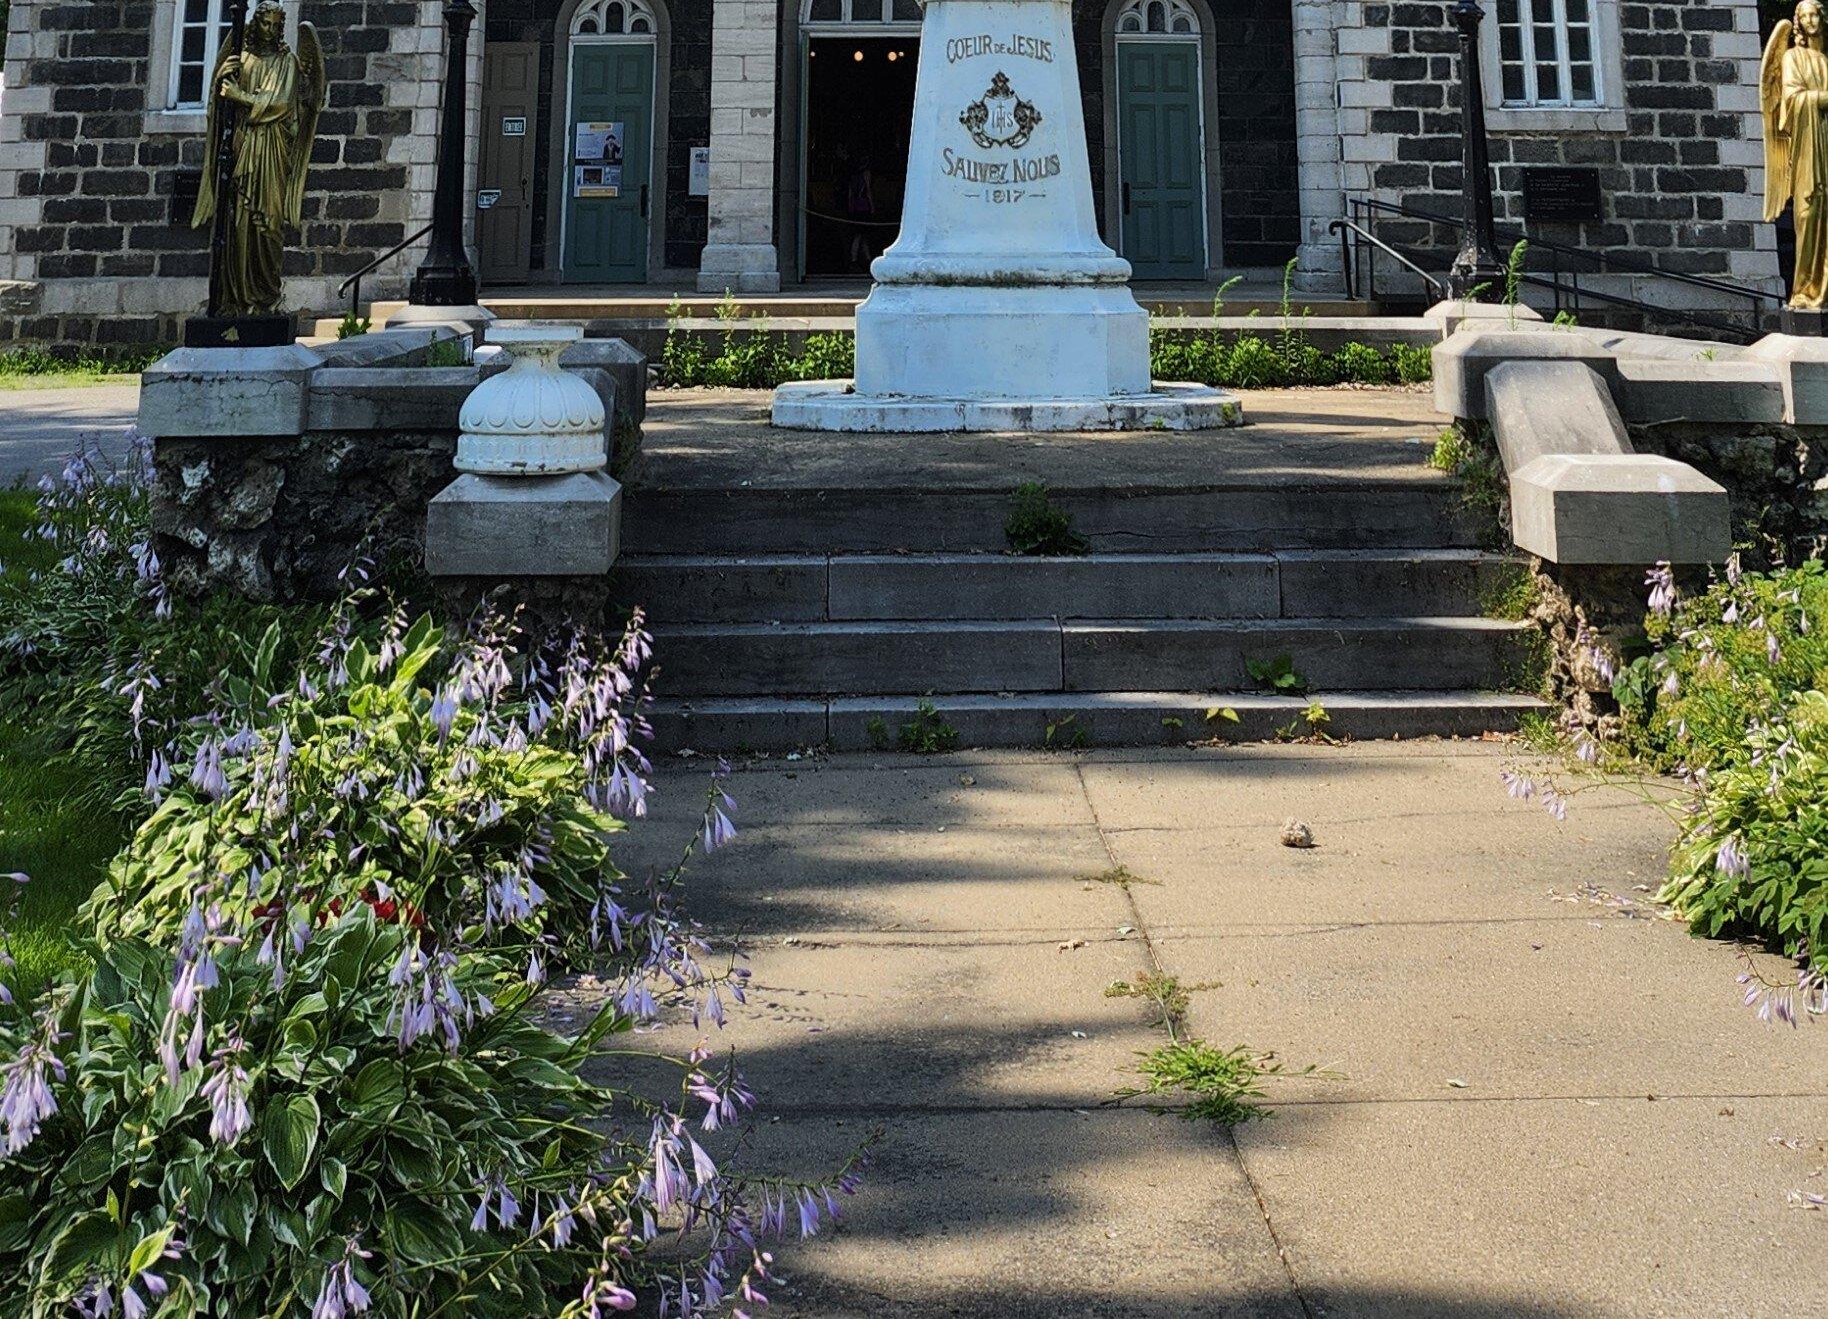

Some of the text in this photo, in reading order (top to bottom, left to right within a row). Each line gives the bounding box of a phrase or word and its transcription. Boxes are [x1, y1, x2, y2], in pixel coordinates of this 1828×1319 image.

[946, 33, 1053, 64] COEUR DE JESUS
[941, 147, 1060, 185] SAUVEZ NOUS
